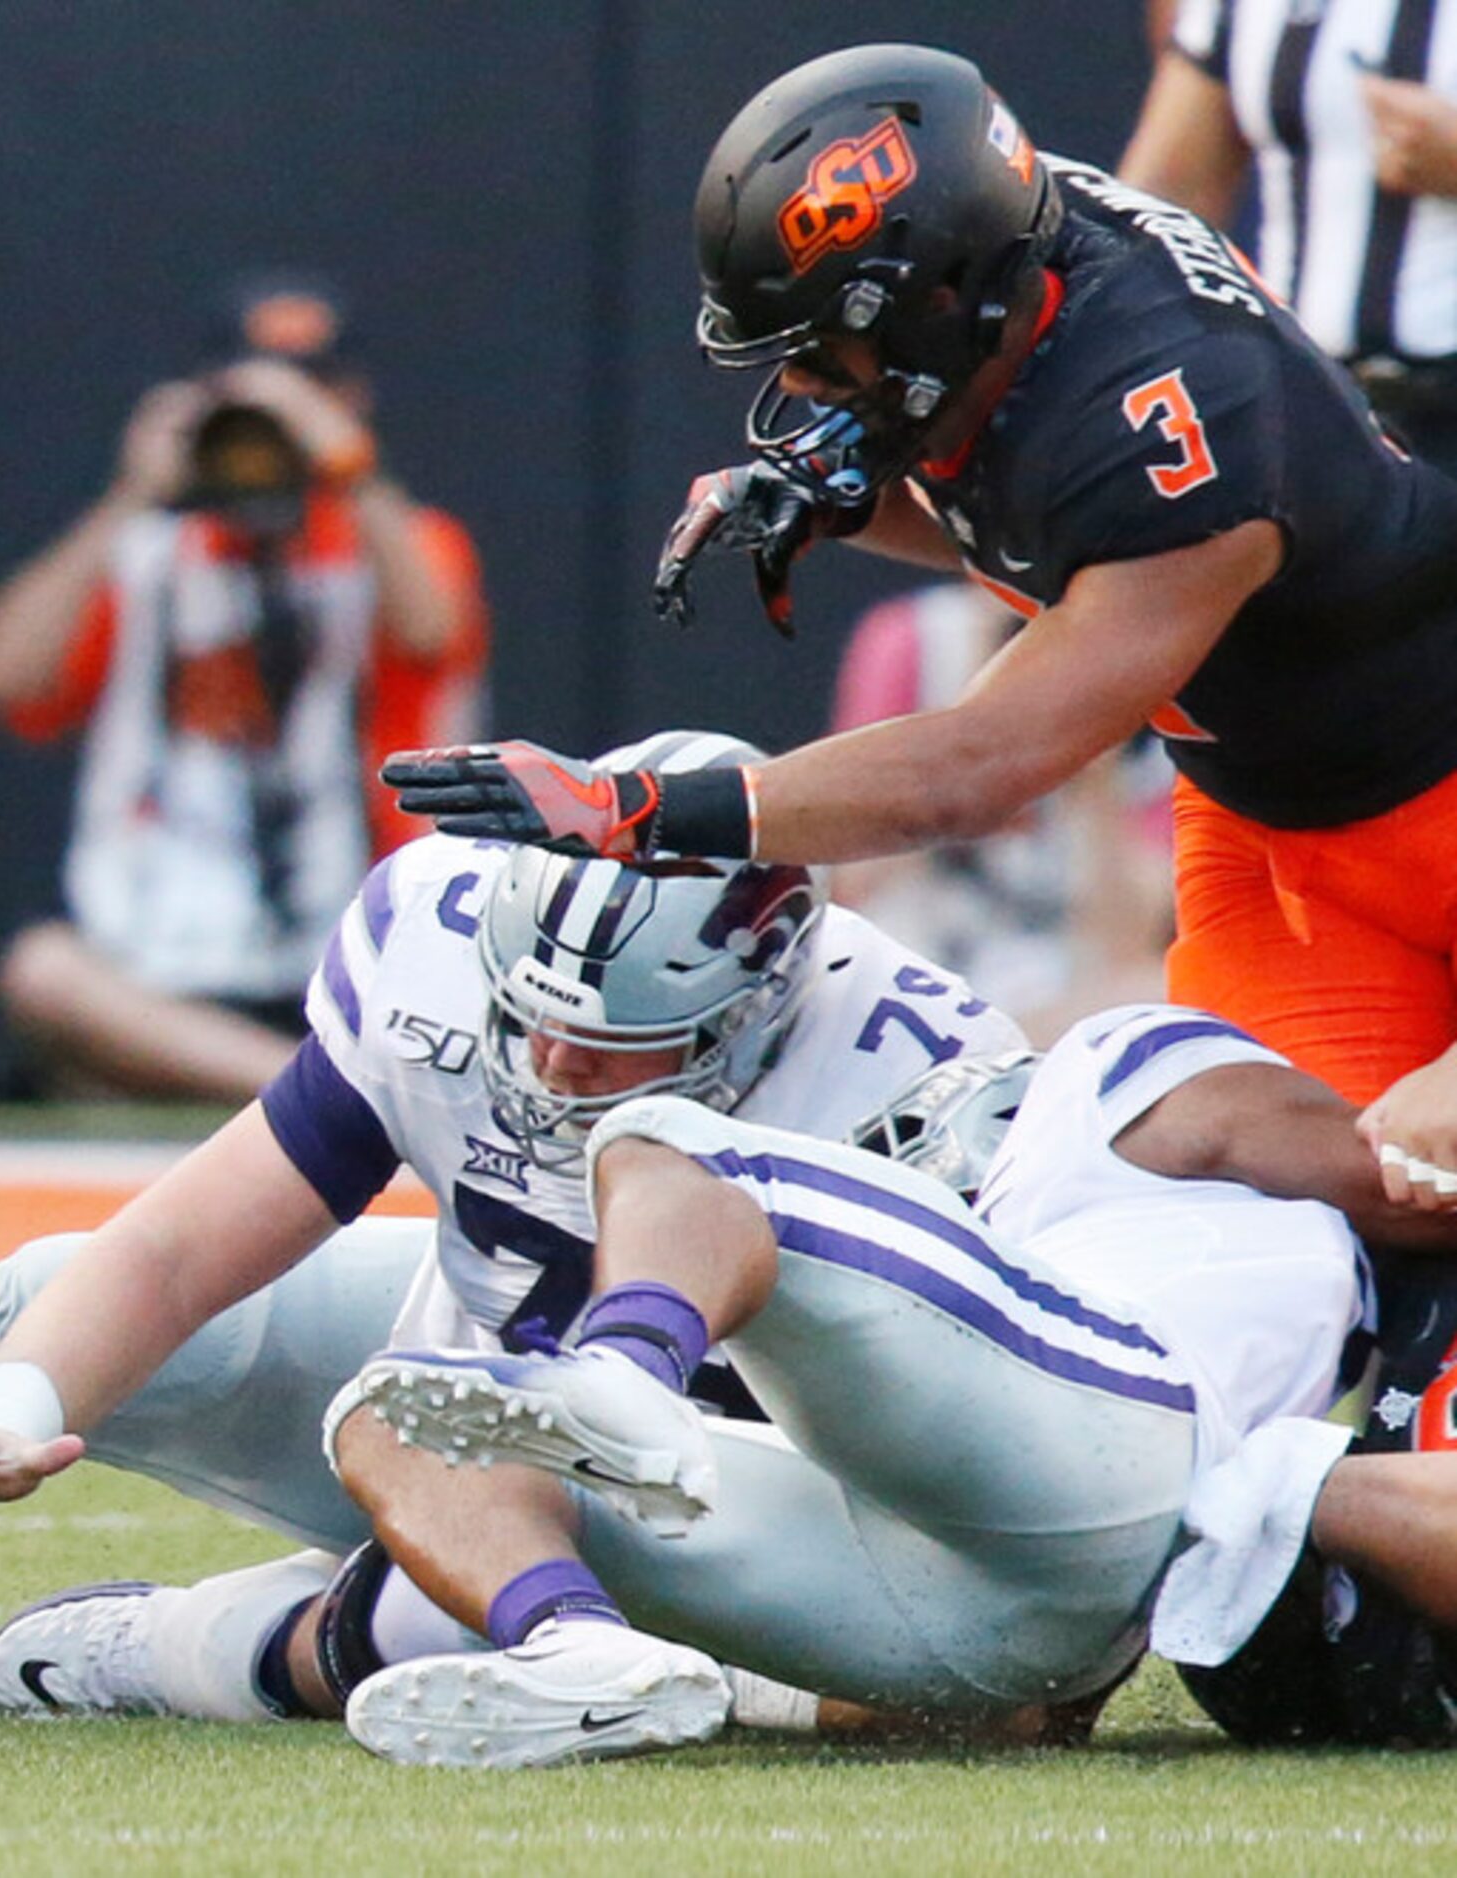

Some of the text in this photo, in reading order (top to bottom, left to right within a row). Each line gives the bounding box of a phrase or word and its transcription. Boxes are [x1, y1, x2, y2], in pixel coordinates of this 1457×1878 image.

[776, 115, 917, 278] OSU
[1122, 367, 1218, 499] 3
[386, 1008, 479, 1076] 150
